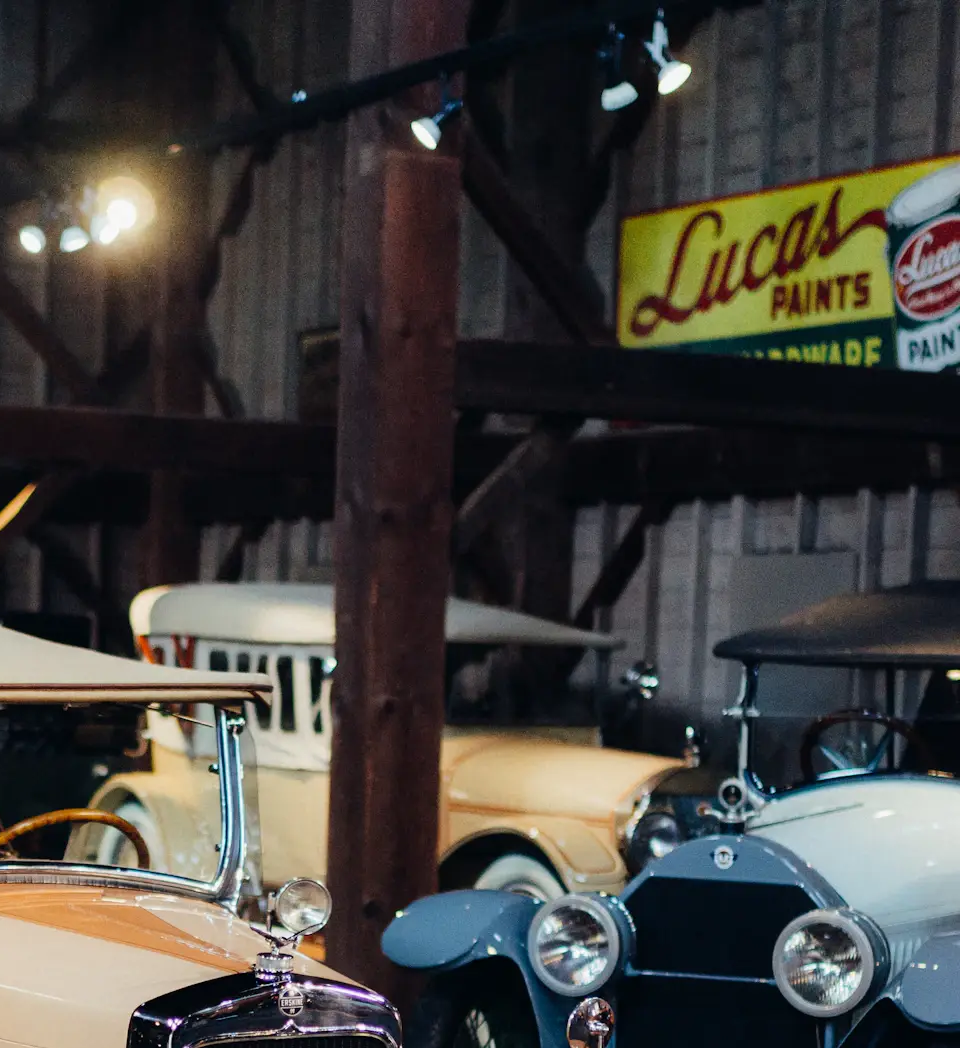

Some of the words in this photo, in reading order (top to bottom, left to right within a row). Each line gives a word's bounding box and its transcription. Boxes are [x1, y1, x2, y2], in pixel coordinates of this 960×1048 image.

[629, 185, 887, 336] Lucas
[771, 272, 870, 320] PAINTS
[908, 328, 960, 364] PAIN
[281, 999, 303, 1007] ERSKINE
